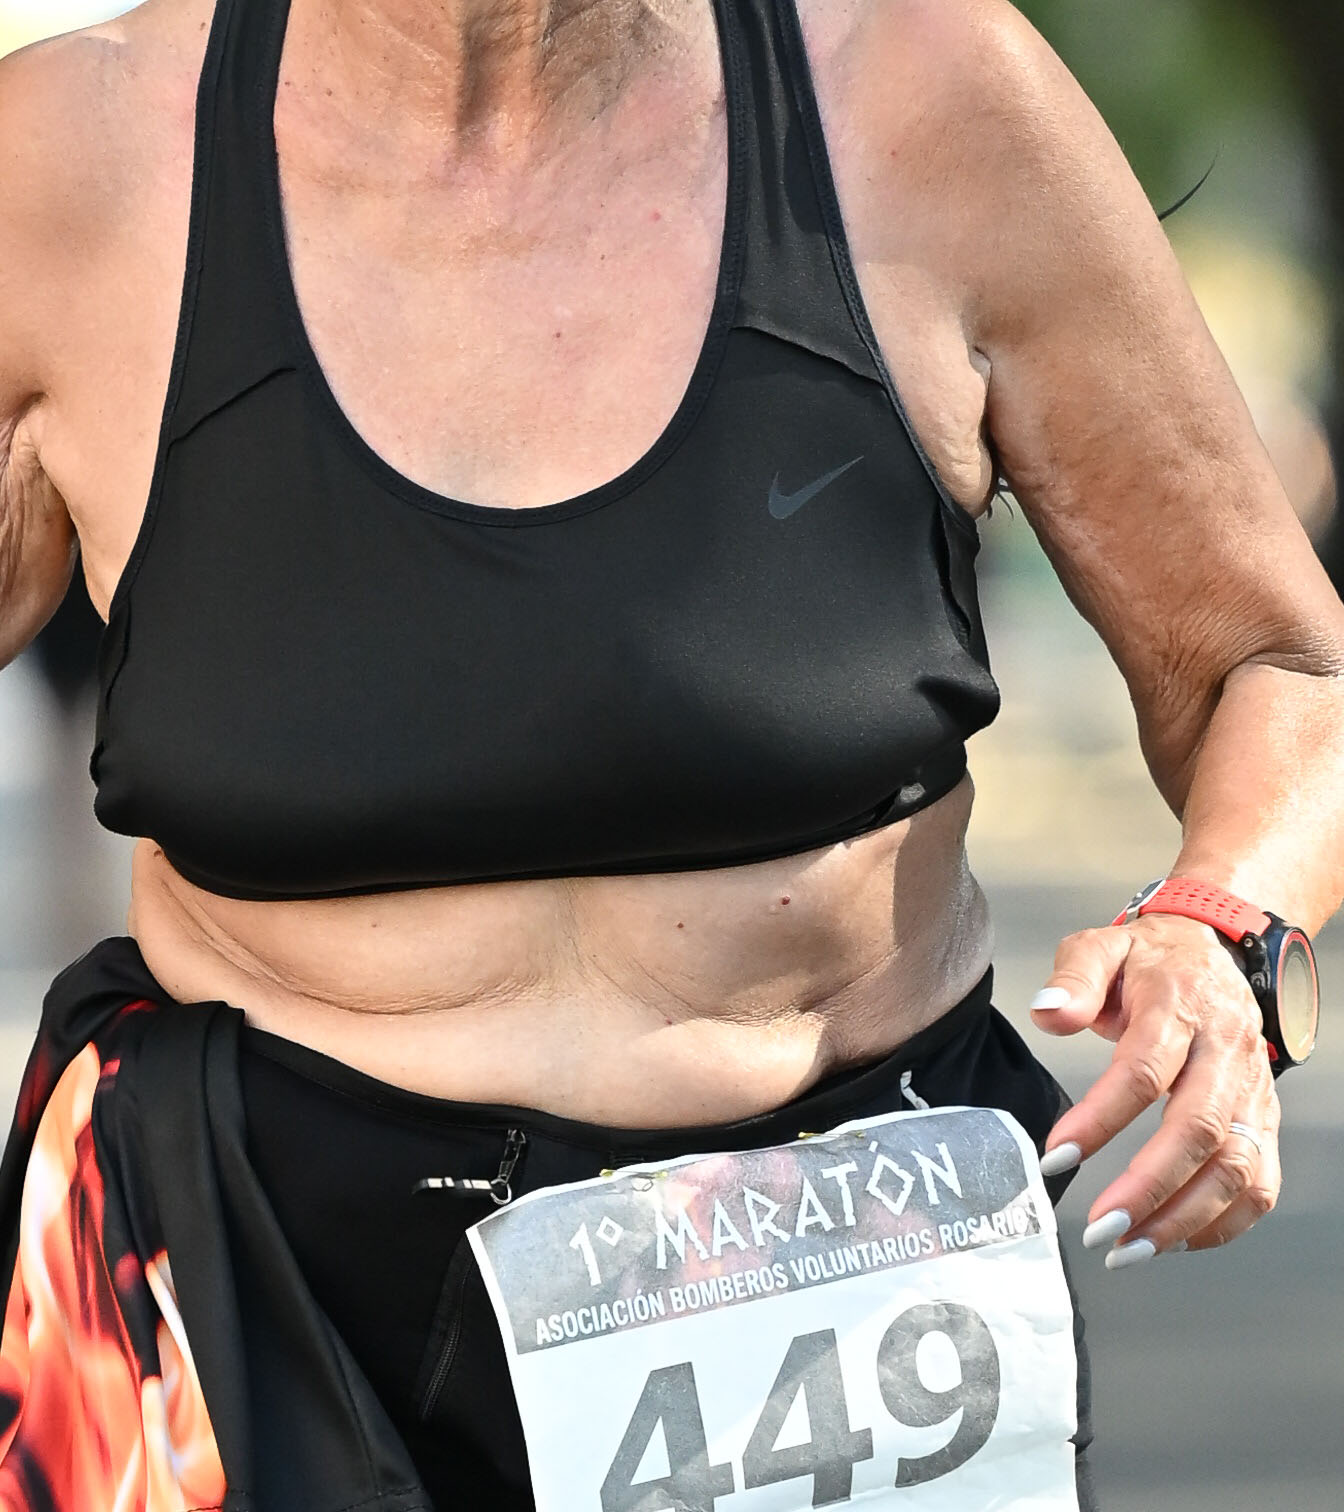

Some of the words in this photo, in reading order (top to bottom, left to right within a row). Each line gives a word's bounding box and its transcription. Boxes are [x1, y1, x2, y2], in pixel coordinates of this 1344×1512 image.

[656, 1141, 962, 1270] MARATÓN
[536, 1289, 665, 1345] ASOCIACIÓN
[669, 1262, 789, 1313] BOMBEROS
[790, 1228, 935, 1284] VOLUNTARIOS
[939, 1206, 1029, 1249] ROSARIO
